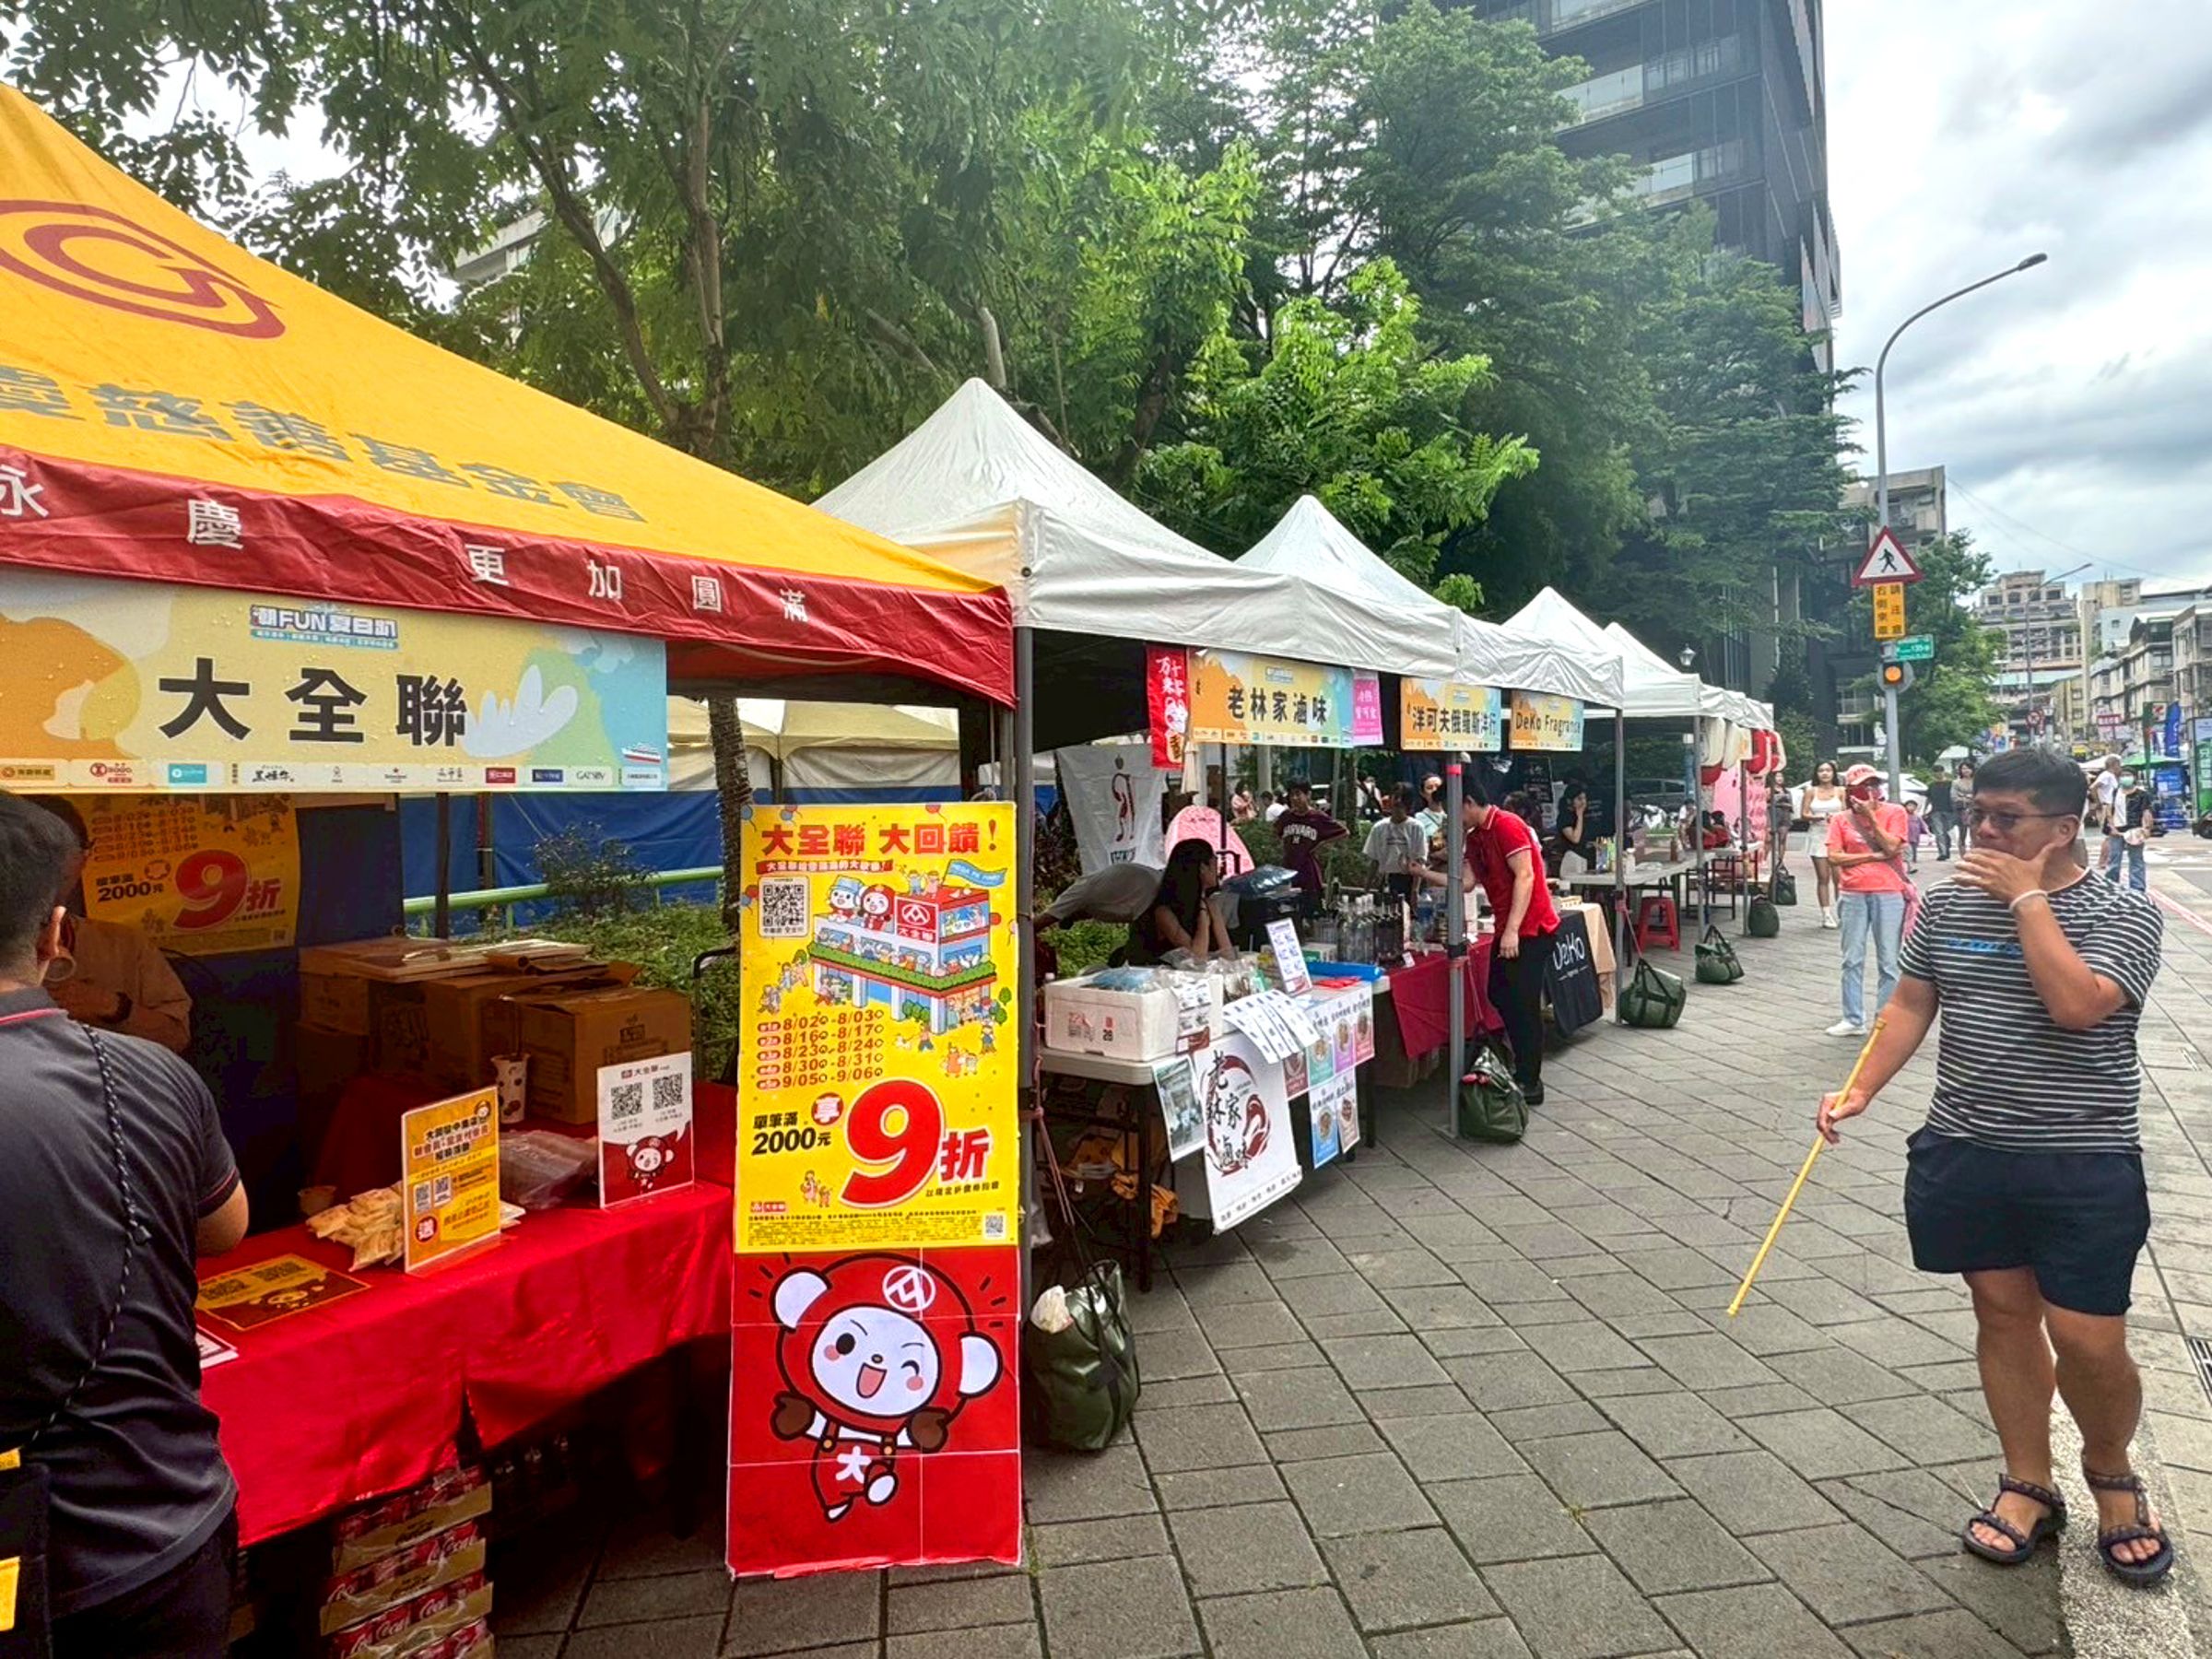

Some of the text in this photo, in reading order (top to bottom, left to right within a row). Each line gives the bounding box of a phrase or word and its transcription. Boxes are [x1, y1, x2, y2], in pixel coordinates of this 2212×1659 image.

[158, 657, 467, 747] 大全聯
[1227, 684, 1327, 726] 老林家滷味
[1515, 712, 1542, 731] DeKo
[761, 824, 866, 855] 大全聯
[98, 881, 164, 902] 2000元
[753, 1112, 798, 1130] 單筆滿
[751, 1127, 831, 1156] 2000元
[841, 1080, 992, 1206] 9折
[835, 1445, 871, 1485] 大
